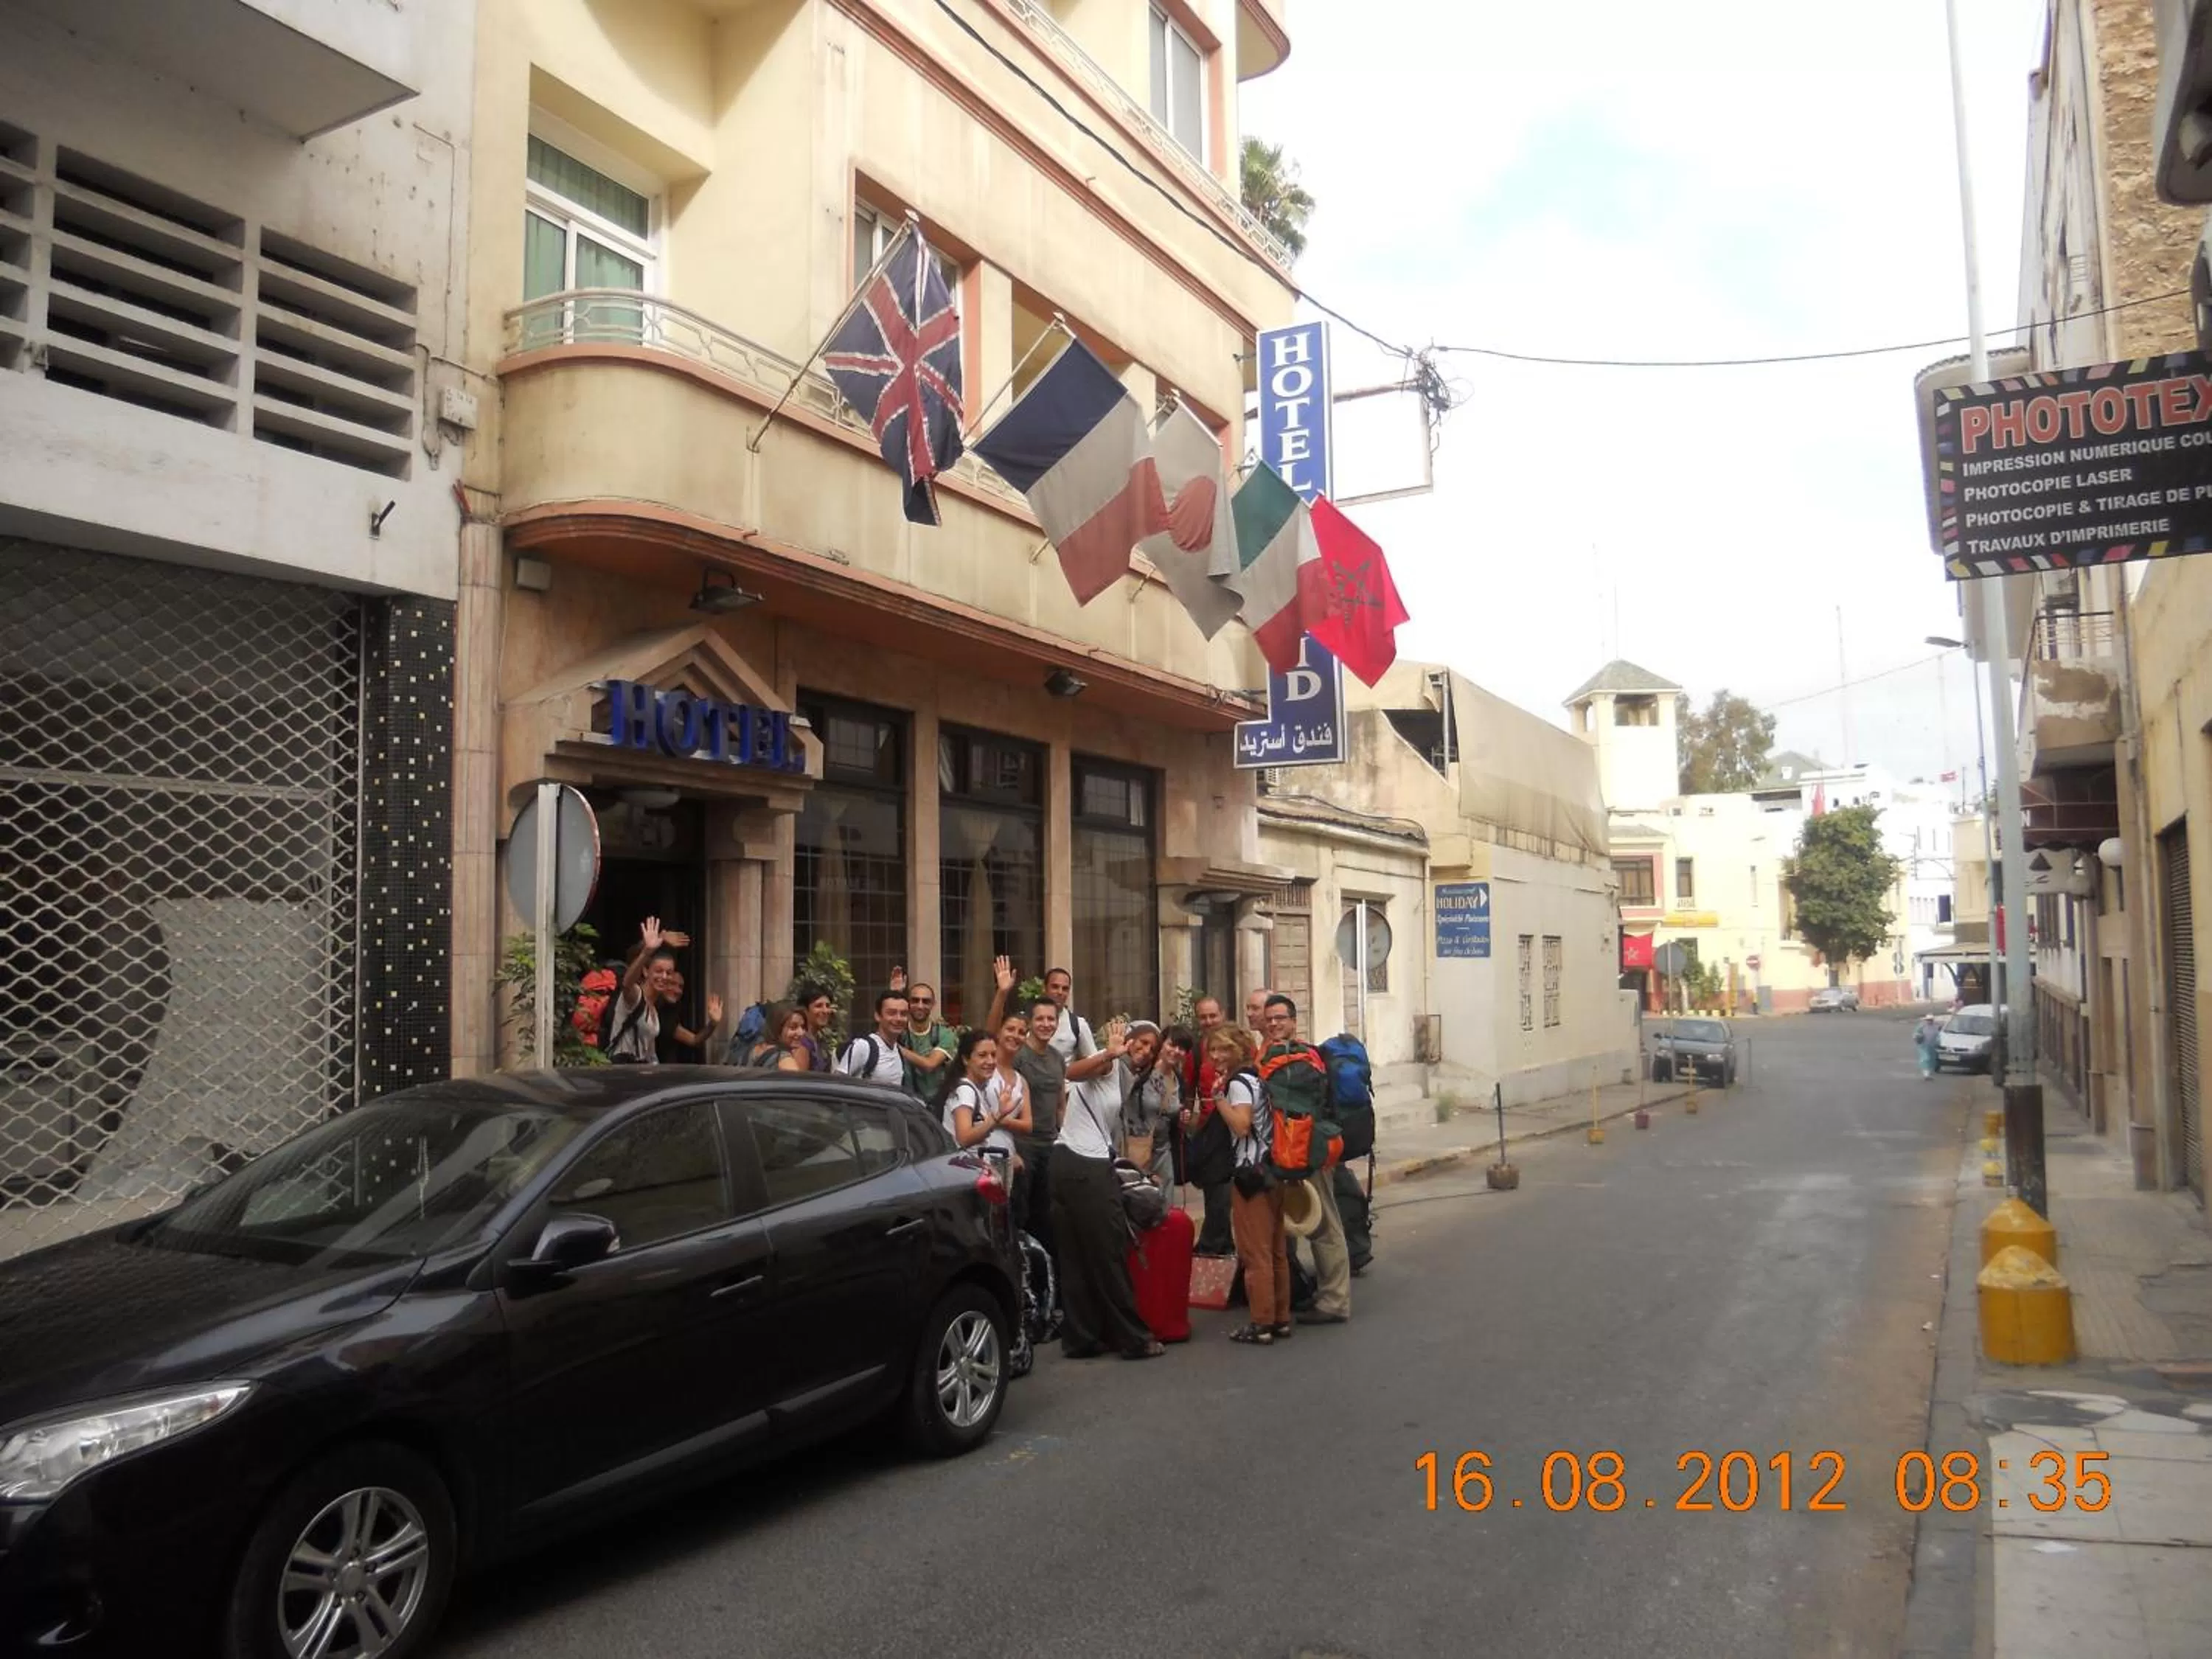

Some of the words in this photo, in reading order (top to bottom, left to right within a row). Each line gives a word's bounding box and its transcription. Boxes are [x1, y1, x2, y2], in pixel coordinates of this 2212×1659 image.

[1270, 332, 1313, 492] HOTEL
[1963, 451, 2065, 477] IMPRESSION
[2070, 436, 2175, 462] NUMERIQUE
[1964, 476, 2071, 502] PHOTOCOPIE
[2076, 468, 2132, 487] LASER
[1966, 501, 2074, 528] PHOTOCOPIE
[2079, 501, 2092, 514] &
[2096, 491, 2161, 512] TIRAGE
[2166, 487, 2191, 502] DE
[1967, 534, 2045, 554] TRAVAUX
[2051, 518, 2170, 544] D'IMPRIMERIE
[606, 679, 805, 773] HOTEL
[1293, 723, 1333, 754] فندق
[1436, 896, 1478, 909] HOLIDAY
